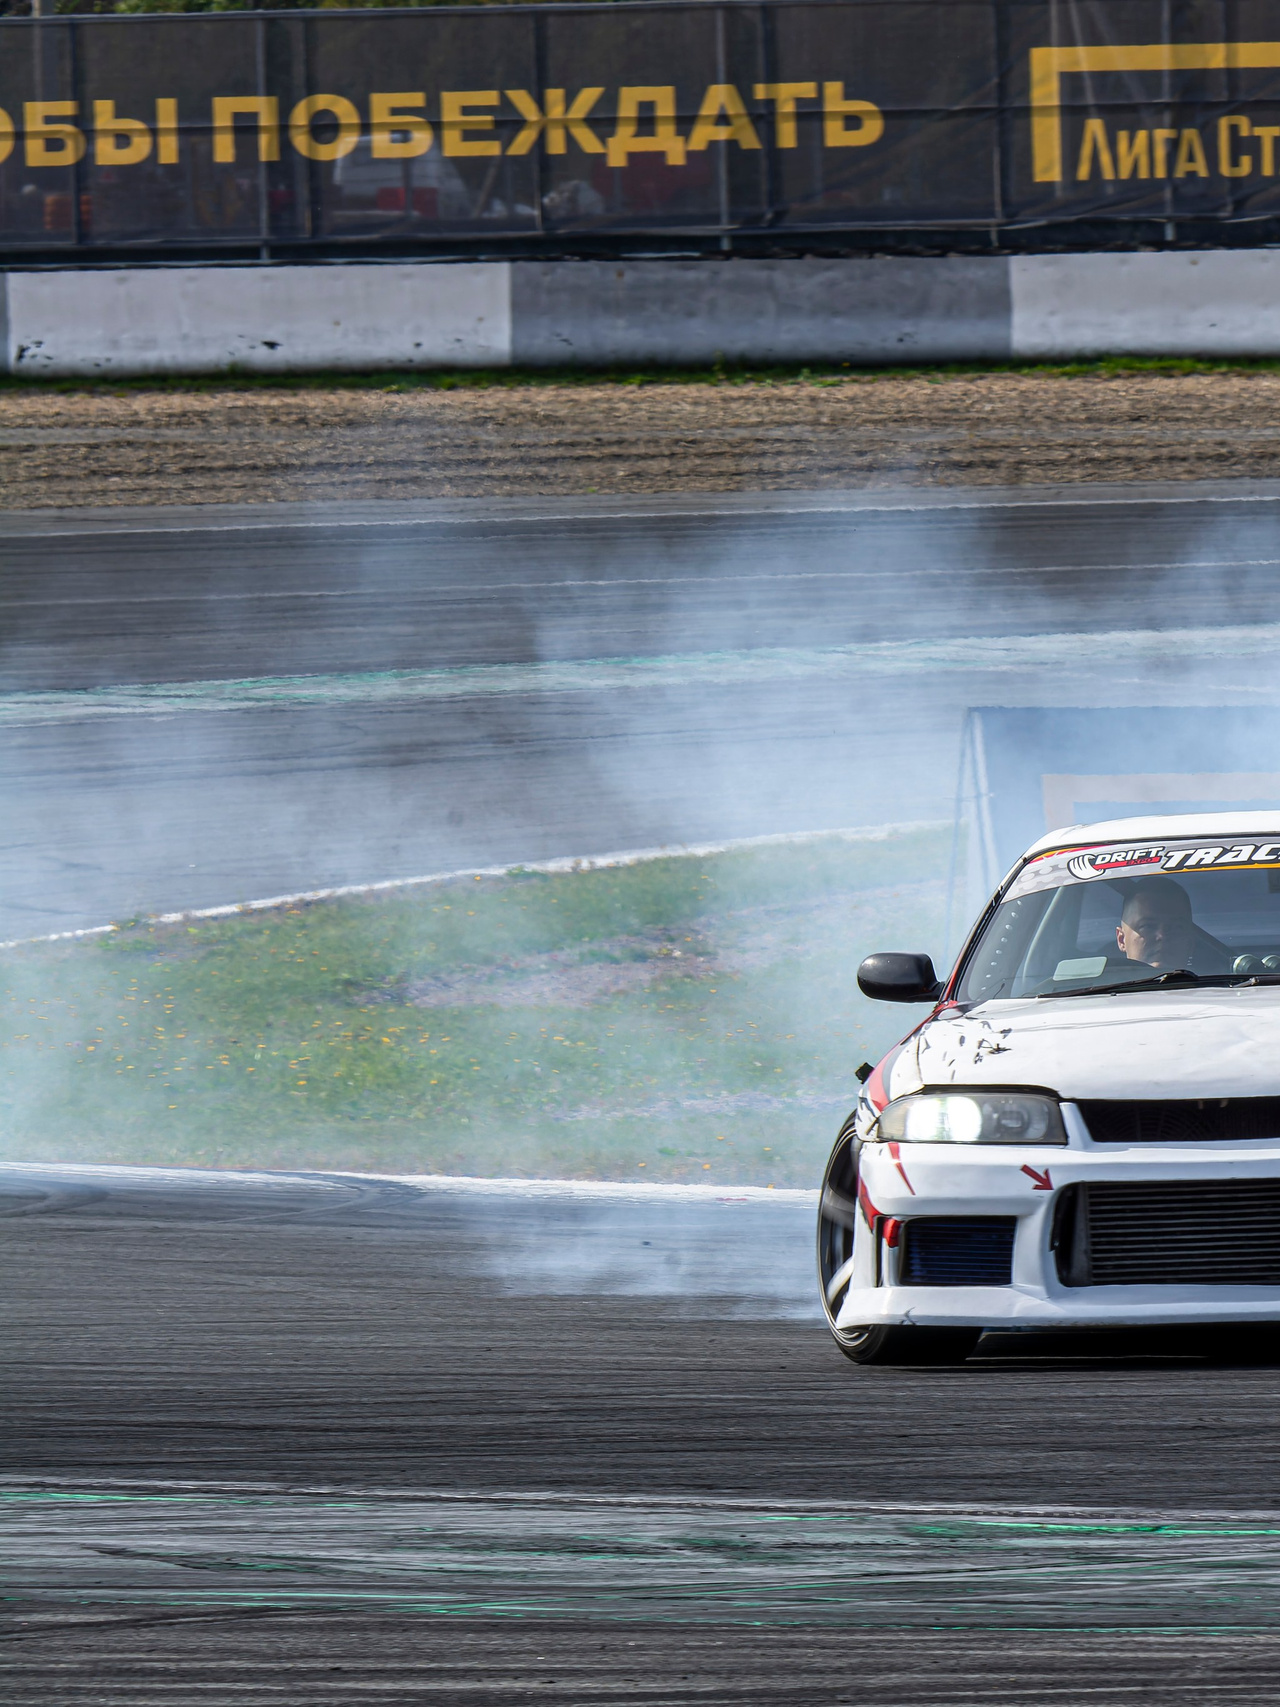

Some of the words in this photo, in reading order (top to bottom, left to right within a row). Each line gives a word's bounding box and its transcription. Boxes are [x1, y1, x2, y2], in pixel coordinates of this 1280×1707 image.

[0, 97, 180, 167] БЫ
[211, 81, 885, 168] ПОБЕЖДАТЬ
[1094, 846, 1165, 866] DRIFT
